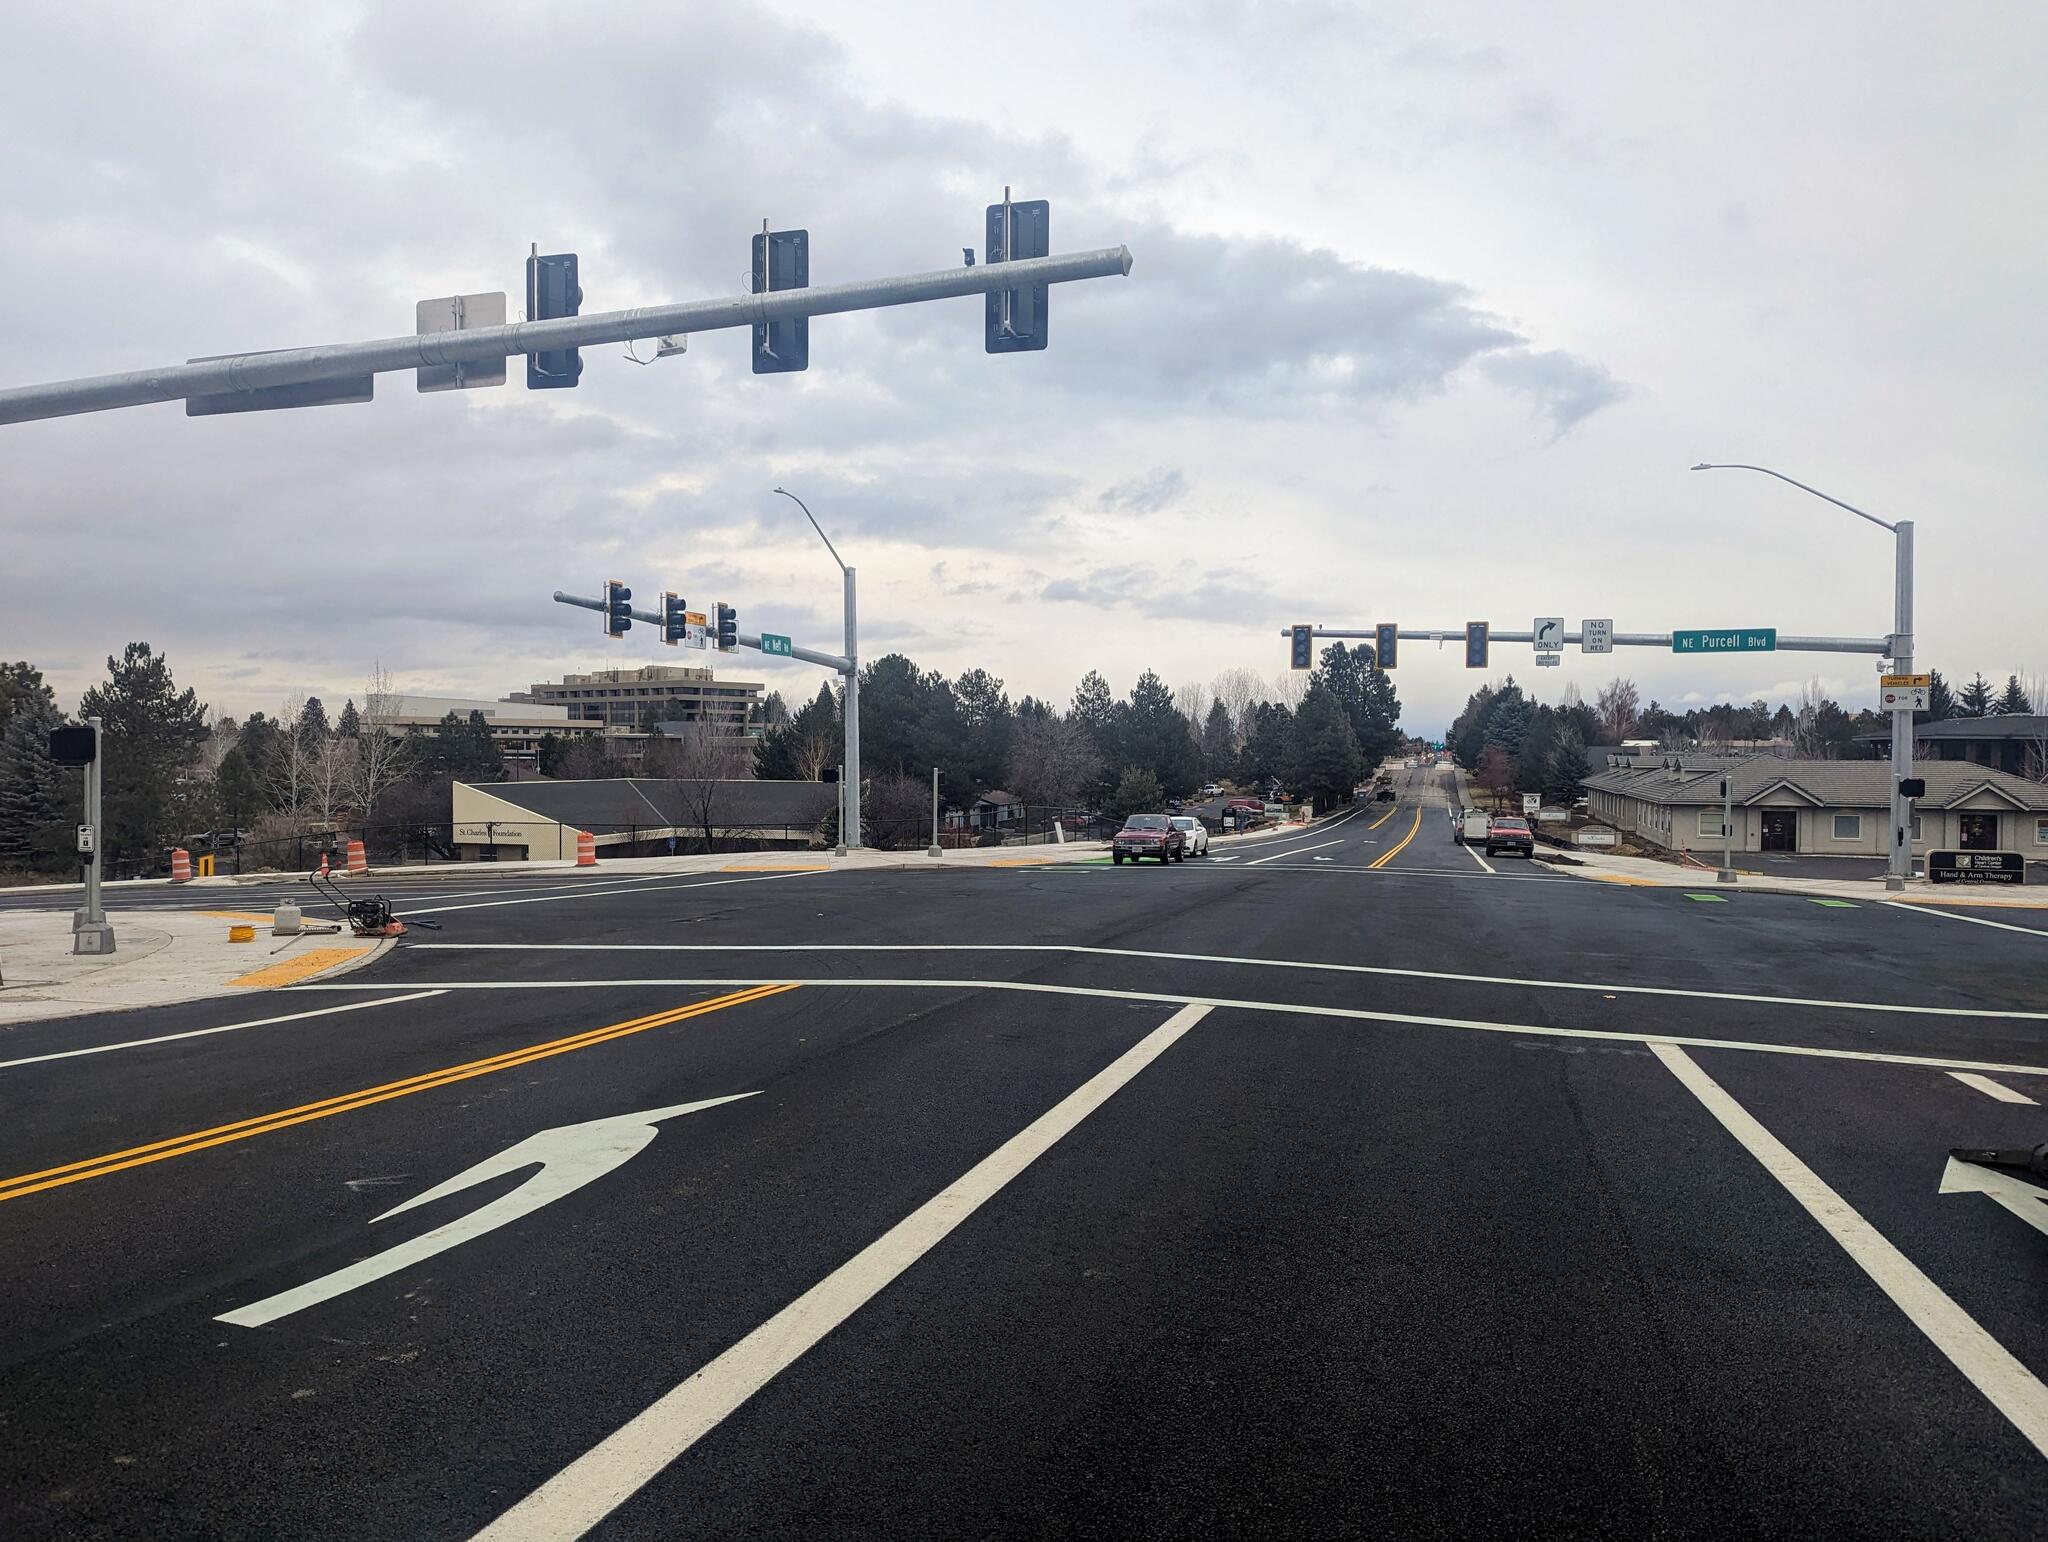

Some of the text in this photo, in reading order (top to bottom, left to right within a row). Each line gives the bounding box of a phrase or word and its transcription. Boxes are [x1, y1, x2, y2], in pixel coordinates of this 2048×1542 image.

[1590, 621, 1605, 629] NO
[1682, 634, 1766, 648] NE Purcell Blvd
[1985, 872, 2013, 880] Therapy
